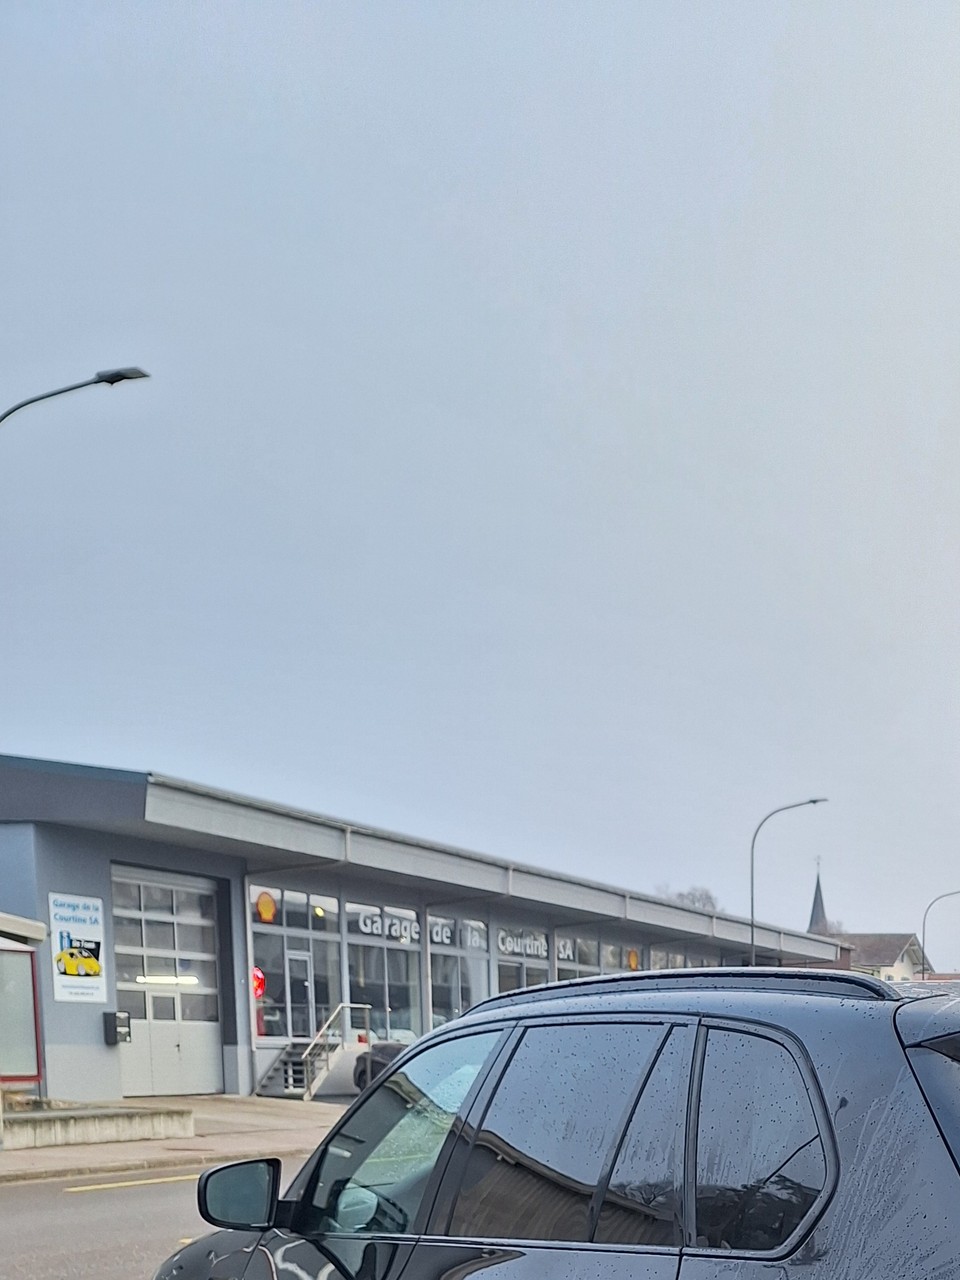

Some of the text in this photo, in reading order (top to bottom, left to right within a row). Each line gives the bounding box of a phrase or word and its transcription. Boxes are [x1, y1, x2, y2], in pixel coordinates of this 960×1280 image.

[53, 899, 99, 912] Garage de la
[54, 912, 99, 925] Courtine SA
[358, 911, 574, 960] Garage de la Courtine SA
